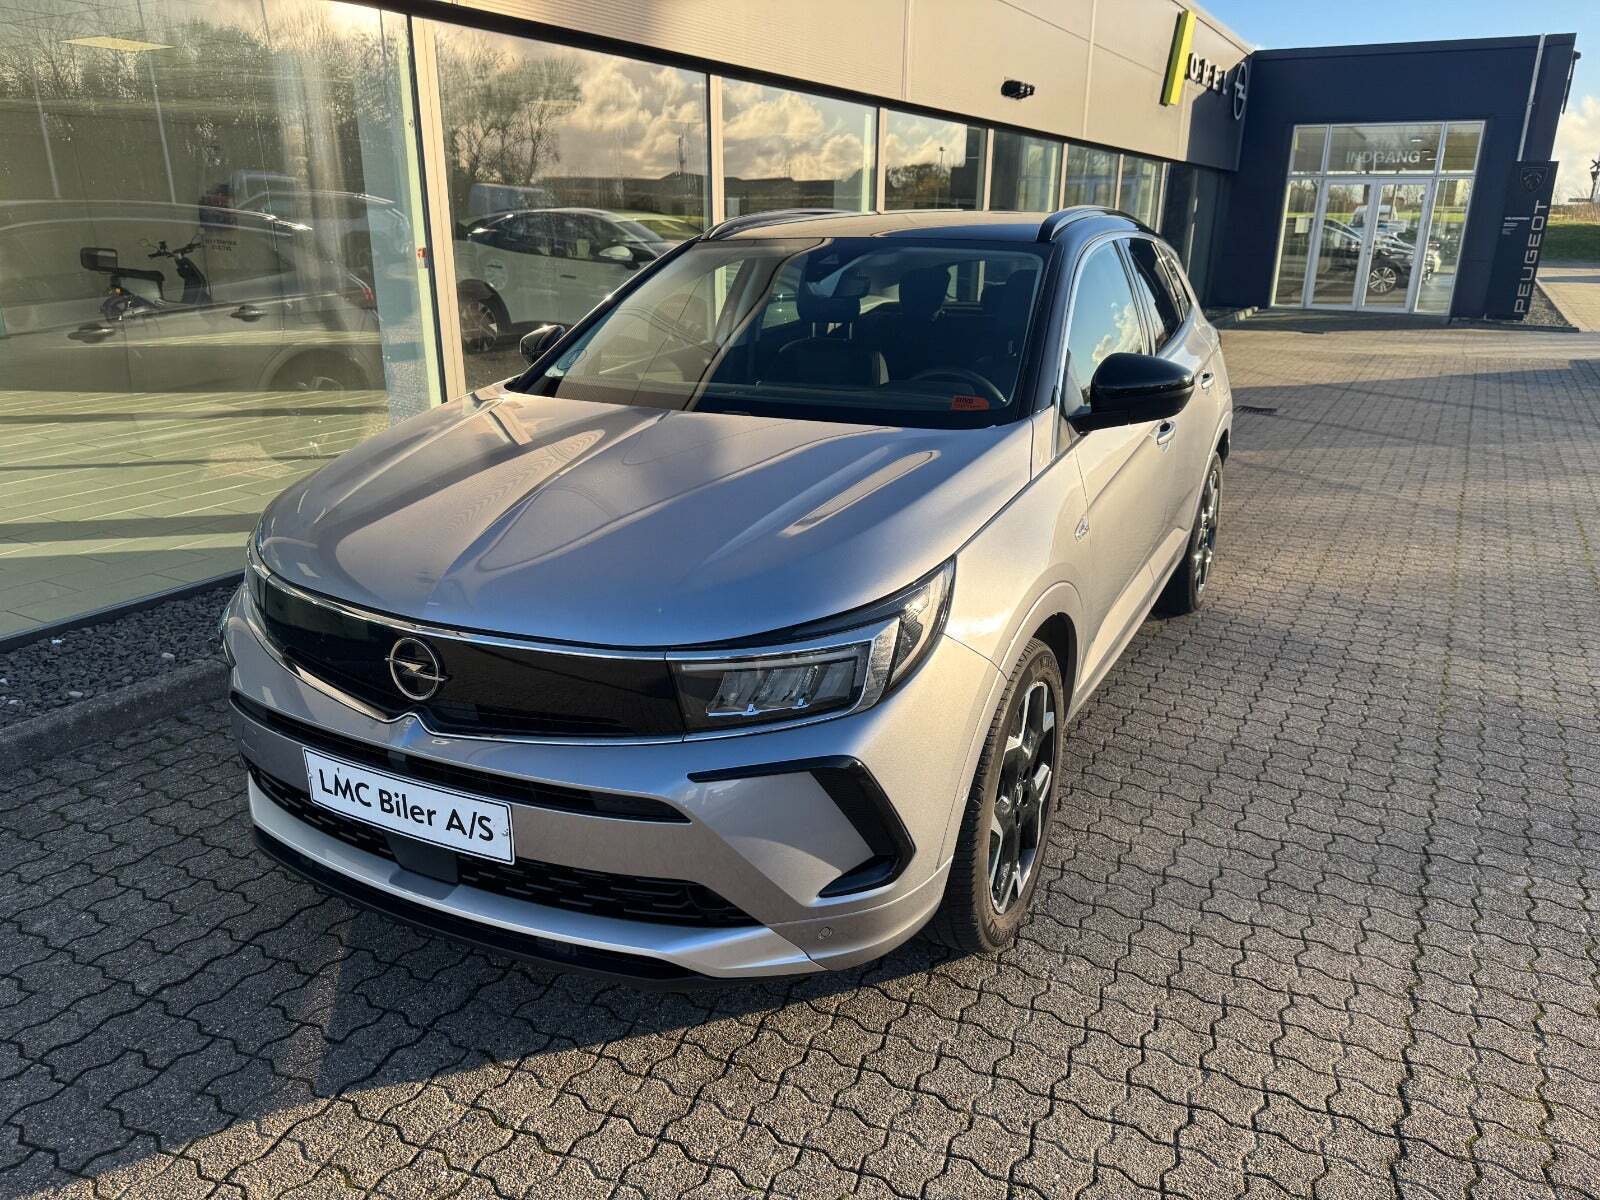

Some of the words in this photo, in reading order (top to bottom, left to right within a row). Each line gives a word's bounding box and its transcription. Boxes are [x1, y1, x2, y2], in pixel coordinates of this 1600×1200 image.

[1189, 51, 1228, 95] OPEL
[1345, 150, 1421, 164] INDGANG
[1513, 199, 1548, 313] PEUGEOT
[318, 767, 372, 808] LMC
[378, 788, 437, 827] Biler
[445, 808, 495, 842] A/S
